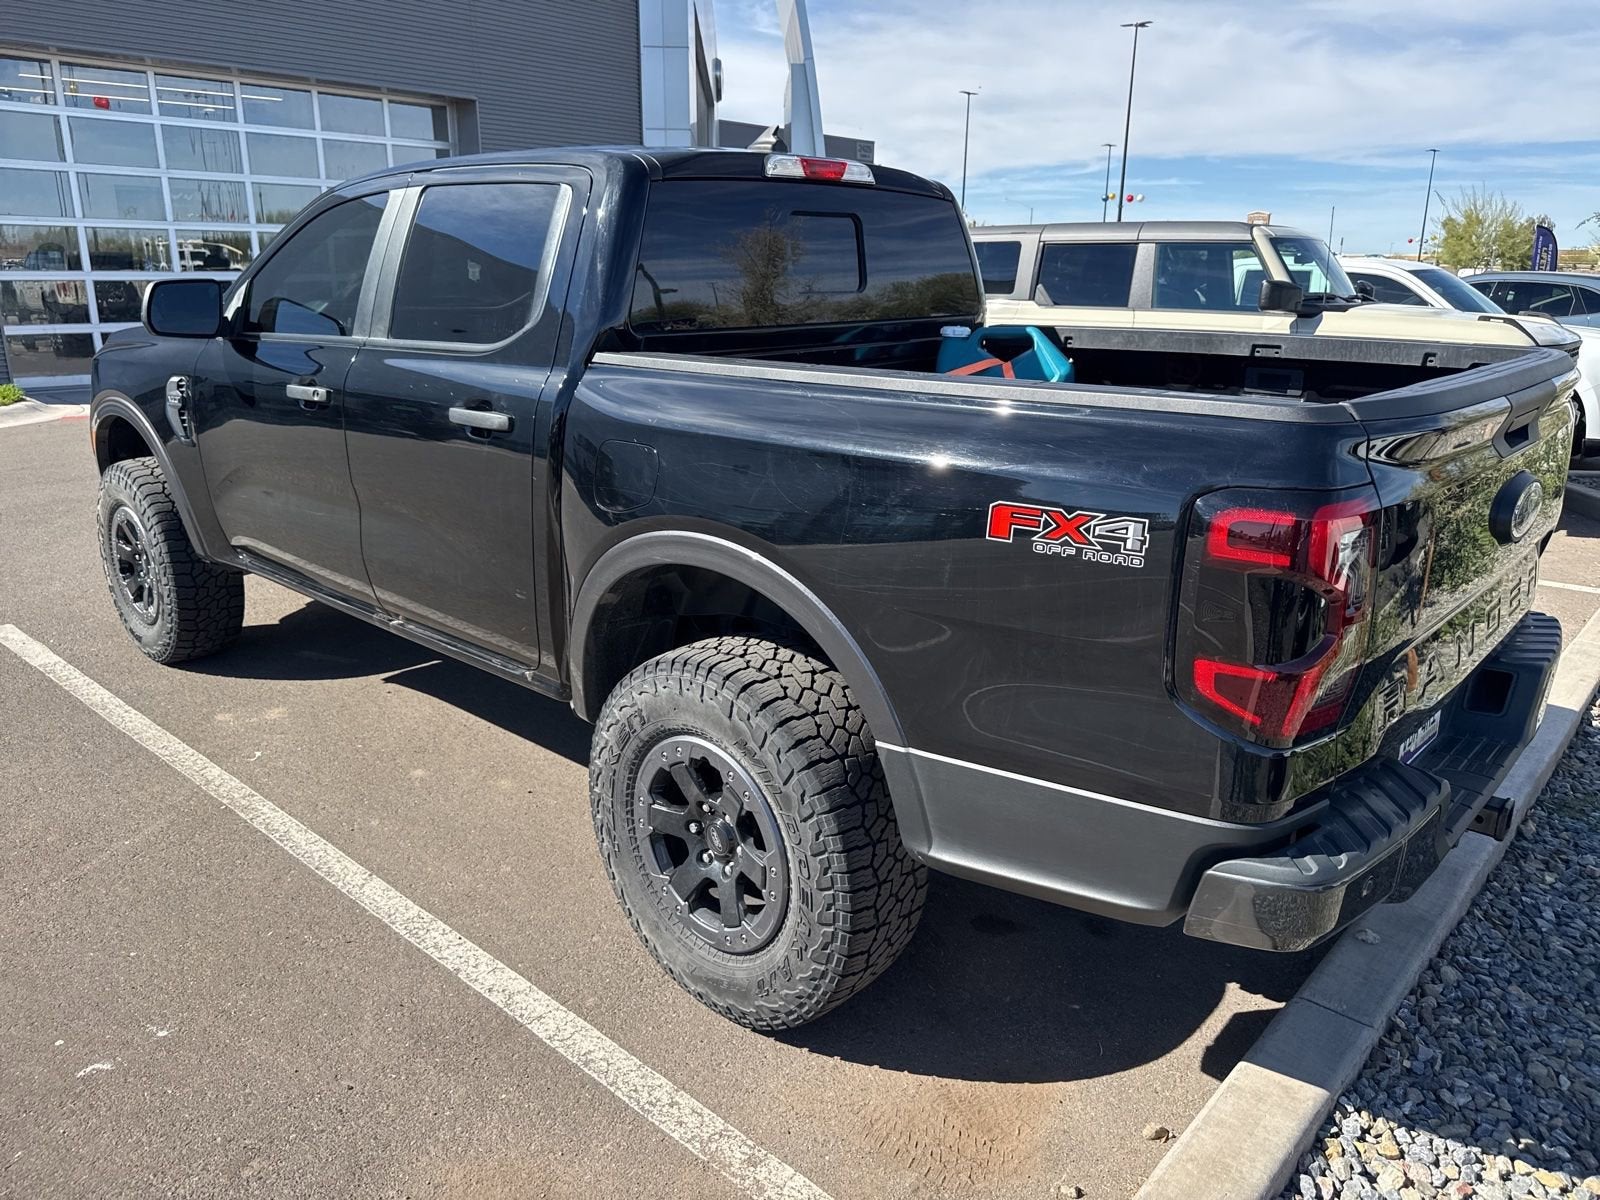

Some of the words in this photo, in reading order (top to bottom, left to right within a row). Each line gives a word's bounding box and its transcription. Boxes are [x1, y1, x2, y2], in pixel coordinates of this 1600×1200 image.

[986, 500, 1150, 556] FX4
[1033, 542, 1076, 557] OFF
[1083, 548, 1144, 568] ROAD
[1376, 559, 1538, 732] RANGER
